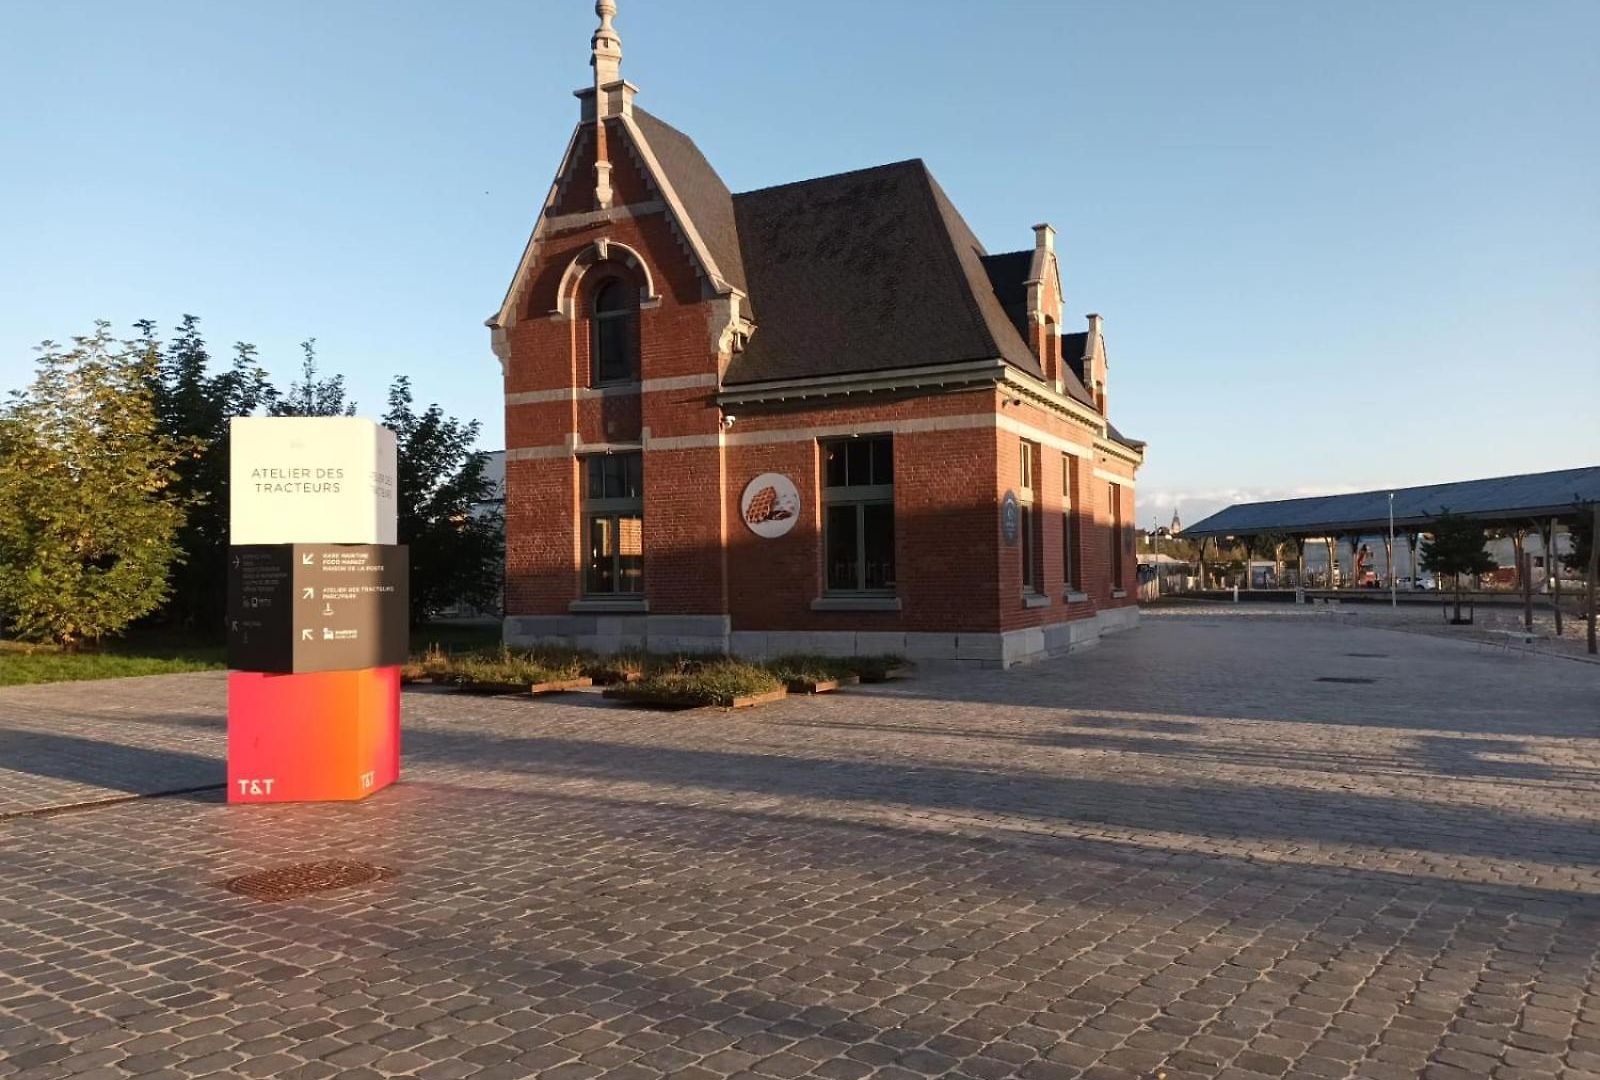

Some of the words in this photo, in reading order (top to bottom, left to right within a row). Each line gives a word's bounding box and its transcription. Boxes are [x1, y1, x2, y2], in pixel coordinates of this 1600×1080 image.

[251, 468, 311, 479] ATELIER
[316, 468, 344, 479] DES
[255, 482, 341, 493] TRACTEURS
[237, 778, 275, 795] T&T
[360, 770, 375, 790] T&T
